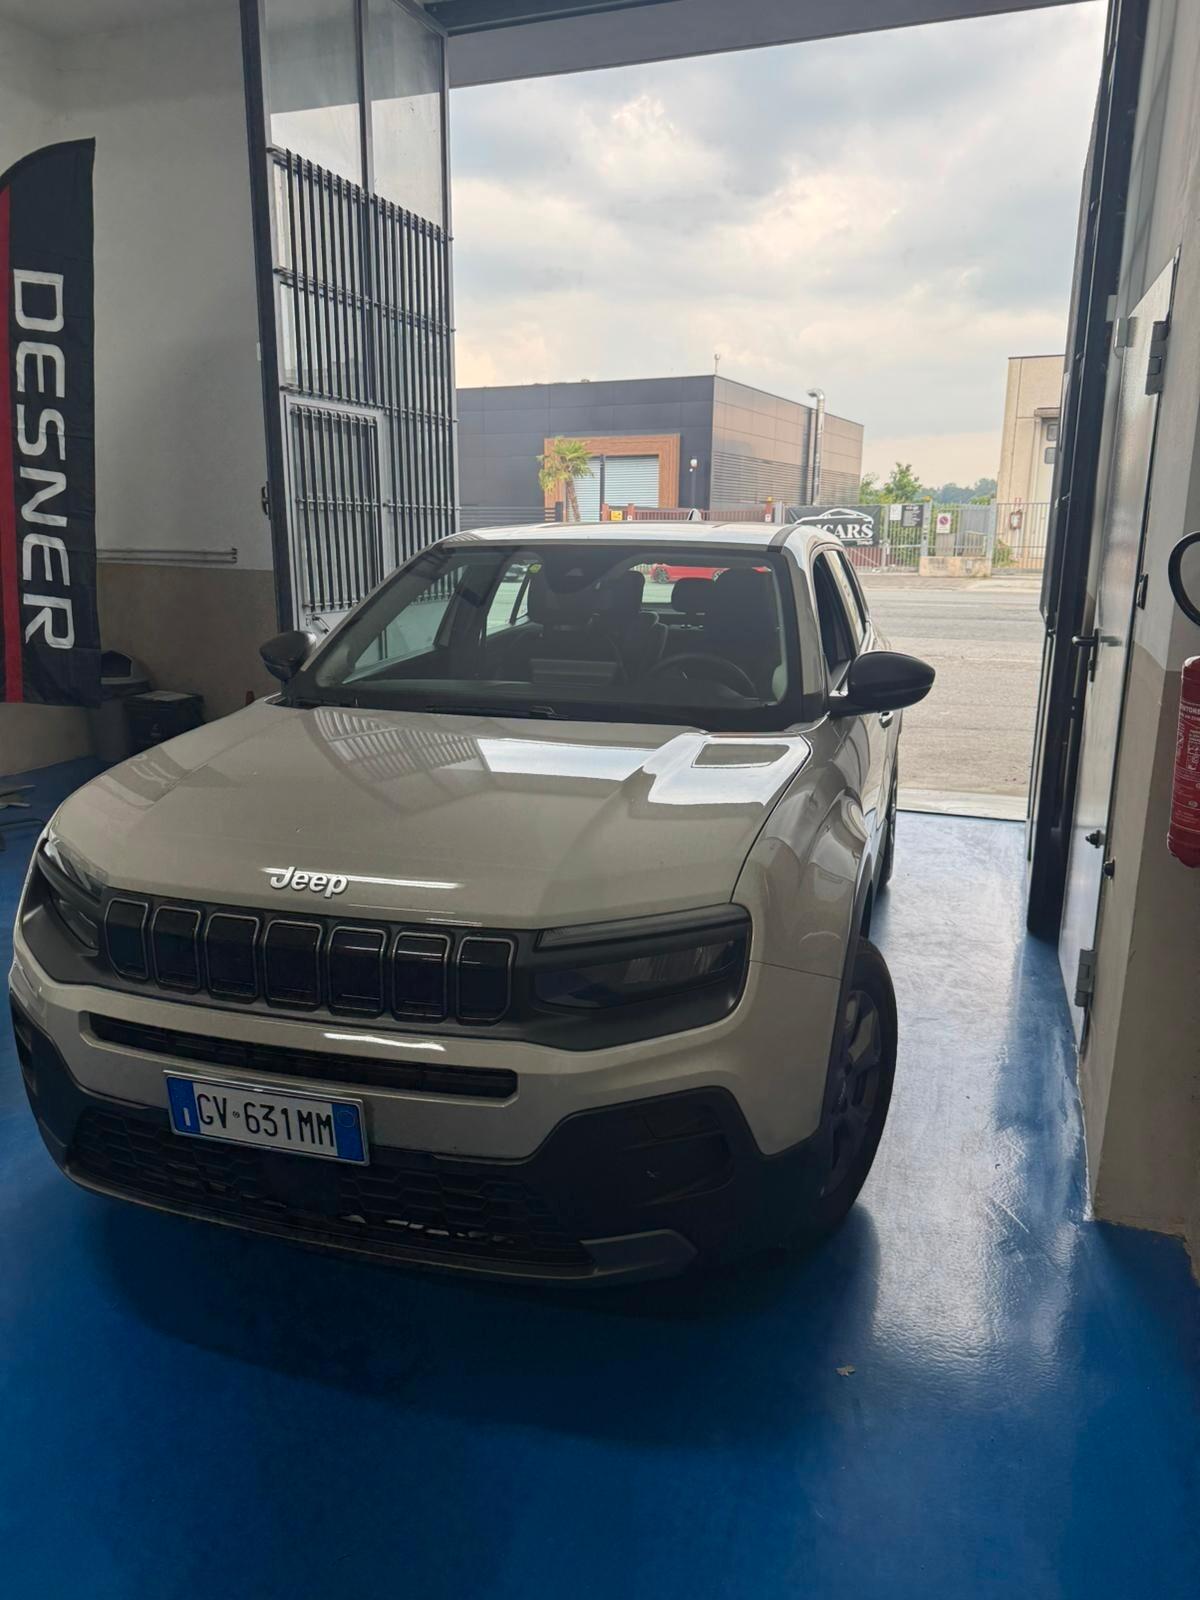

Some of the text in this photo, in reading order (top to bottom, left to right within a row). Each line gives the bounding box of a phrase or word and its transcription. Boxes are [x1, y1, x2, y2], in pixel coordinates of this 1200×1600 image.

[13, 269, 75, 650] DESNER
[270, 866, 348, 899] Jeep
[196, 1093, 335, 1147] GV 631MM
